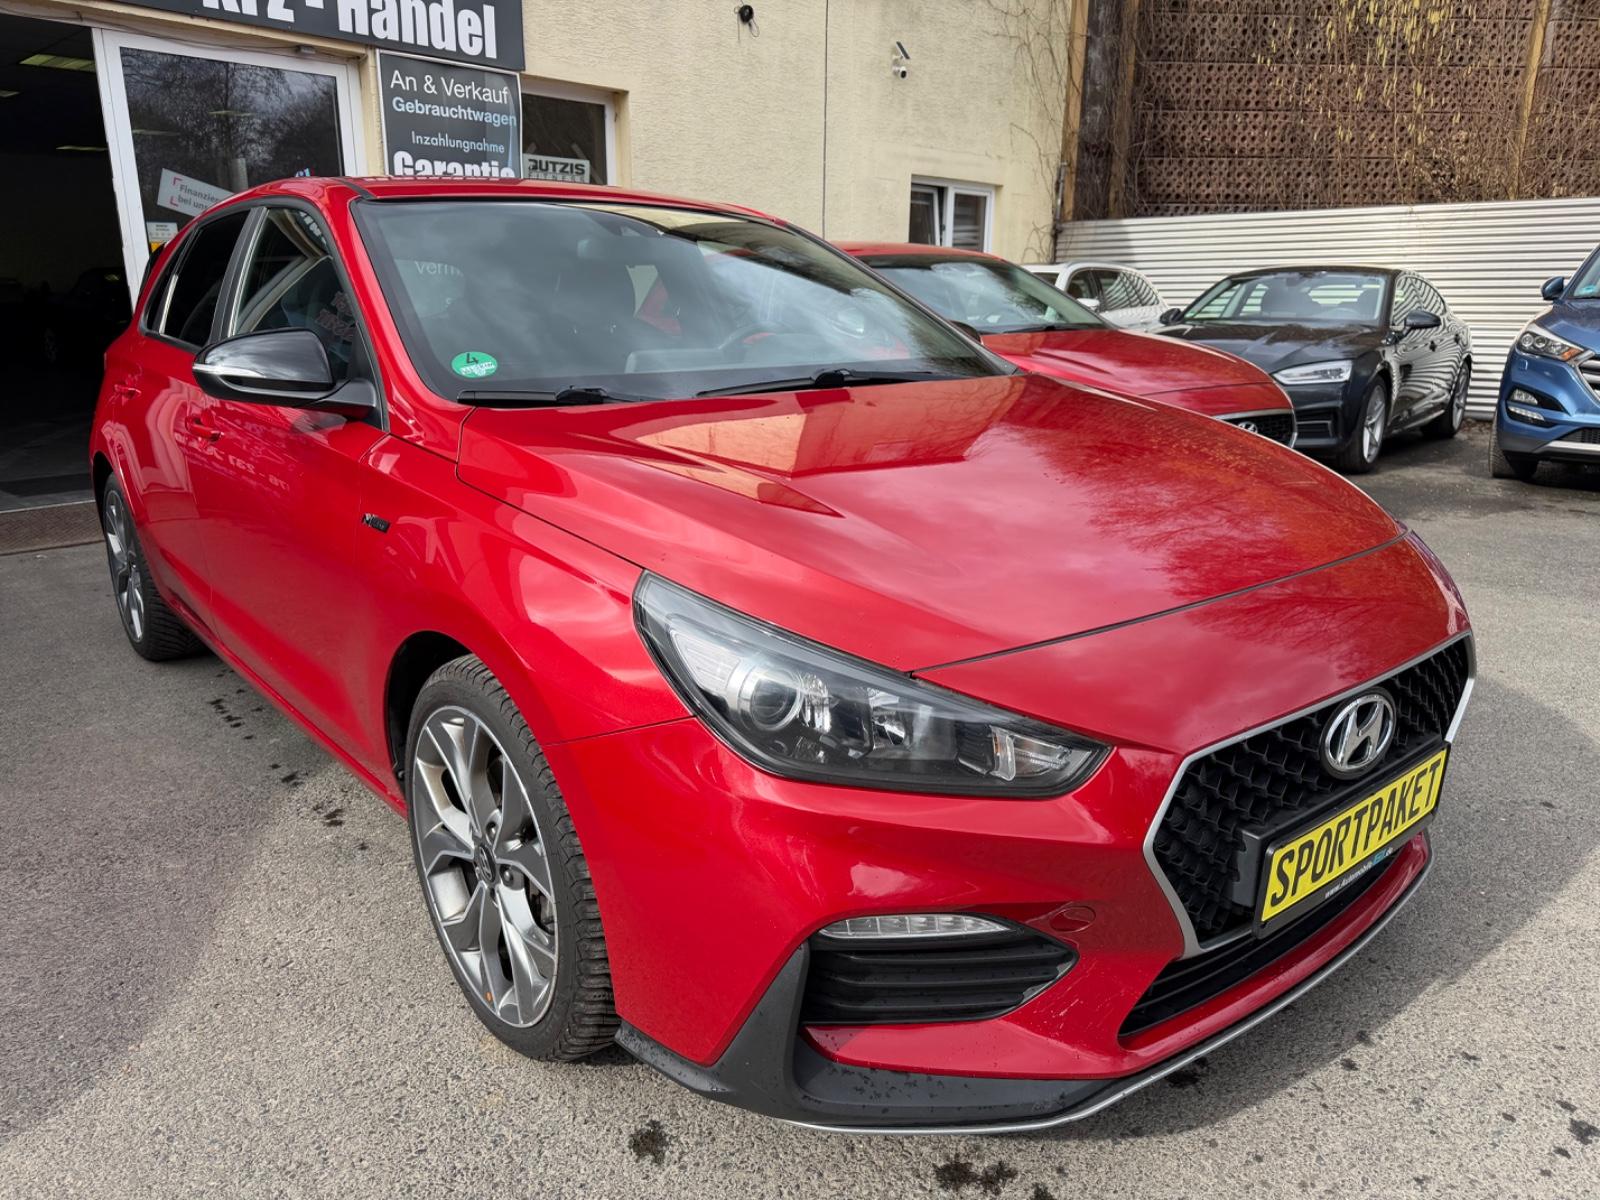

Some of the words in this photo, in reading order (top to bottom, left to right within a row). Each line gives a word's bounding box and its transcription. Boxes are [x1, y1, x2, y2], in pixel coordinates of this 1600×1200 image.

[337, 0, 497, 59] Handel
[390, 69, 418, 92] An
[423, 74, 438, 95] &
[440, 76, 509, 104] Verkauf
[392, 96, 517, 127] Gebrauchtwagen
[411, 130, 505, 154] Inzahlungnahme
[466, 352, 479, 365] 4
[1270, 759, 1441, 907] SPORTPAKET
